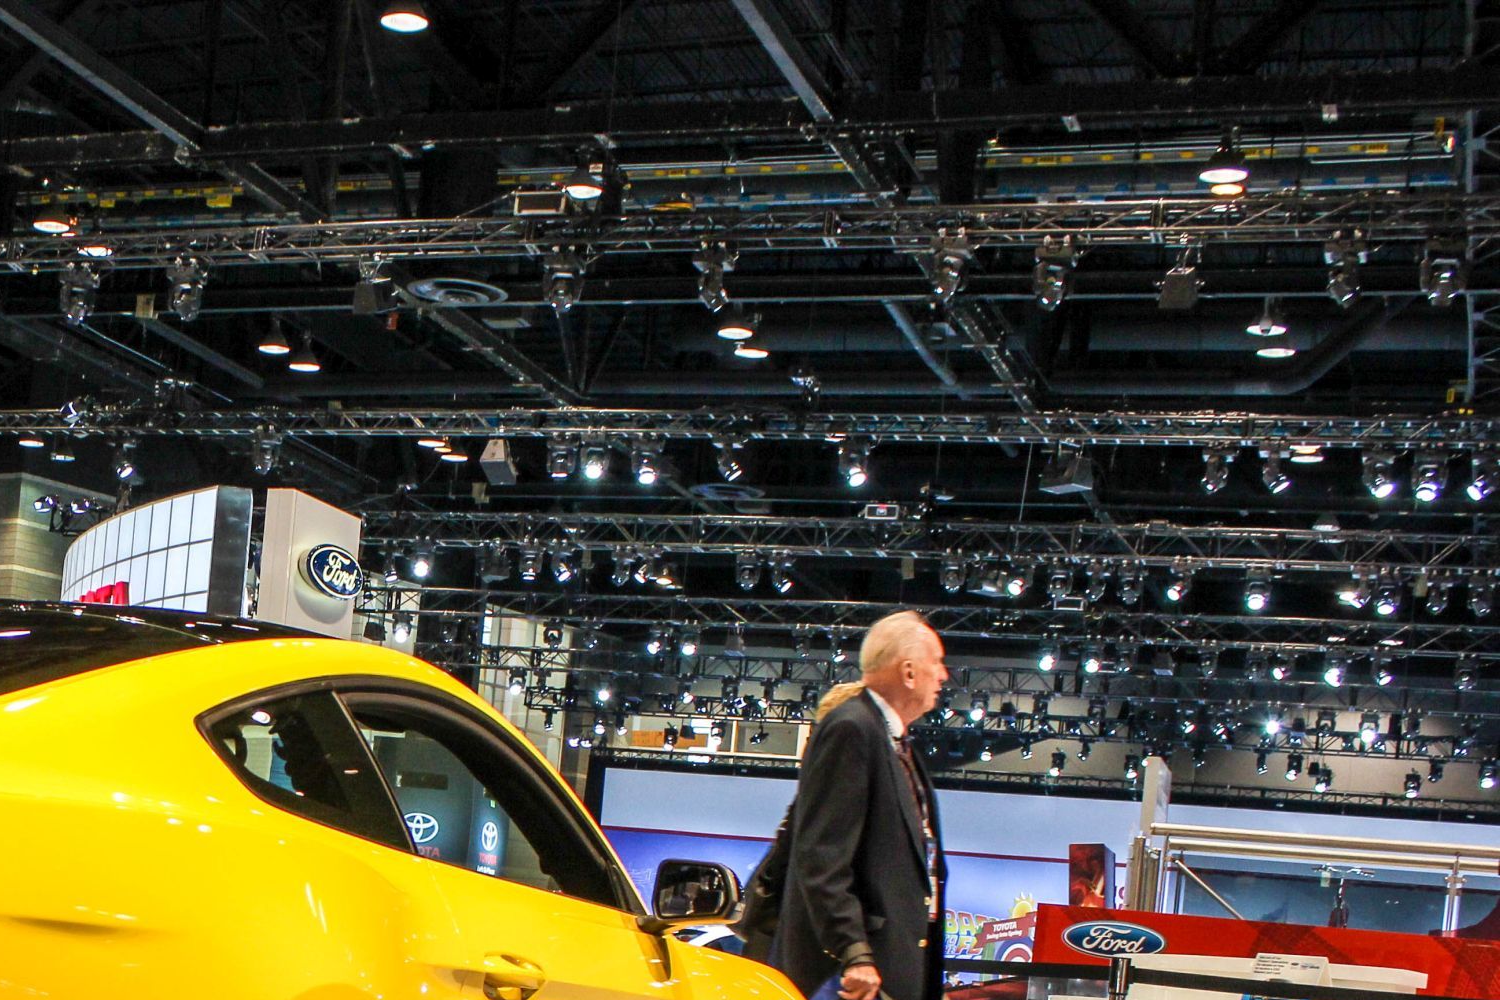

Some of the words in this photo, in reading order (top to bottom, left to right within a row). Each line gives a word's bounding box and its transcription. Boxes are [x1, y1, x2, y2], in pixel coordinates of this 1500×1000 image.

[322, 551, 358, 591] Ford
[993, 921, 1017, 932] TOYOTA
[1082, 925, 1146, 953] Ford
